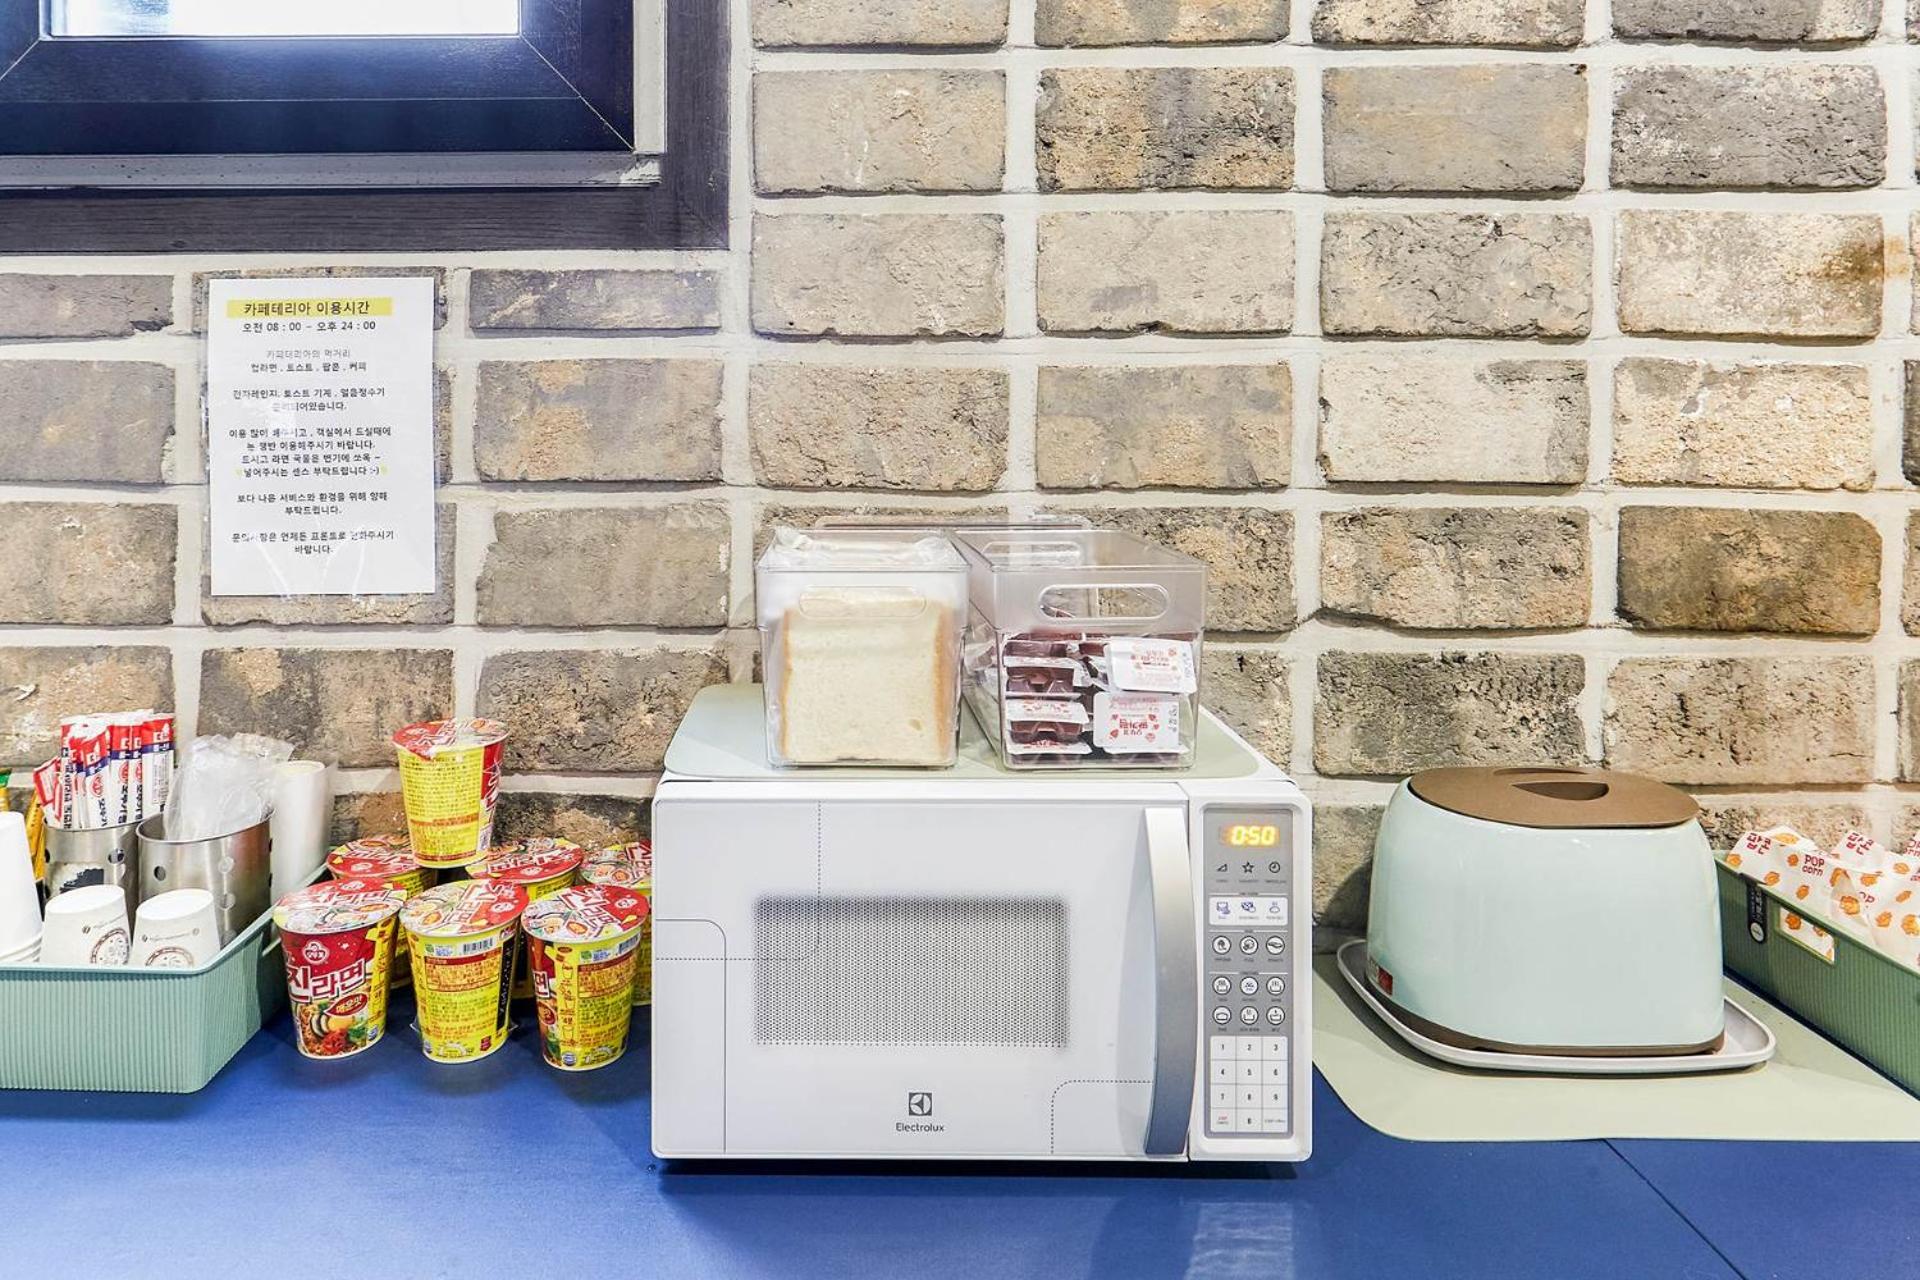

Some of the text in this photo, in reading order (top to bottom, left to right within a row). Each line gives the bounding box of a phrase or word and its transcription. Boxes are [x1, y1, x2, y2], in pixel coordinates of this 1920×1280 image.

[244, 301, 369, 315] 카페테리아 이용시간
[242, 322, 263, 333] 오전
[267, 322, 279, 331] 08
[289, 322, 301, 331] 00
[317, 321, 337, 331] 오후
[341, 321, 353, 330] 24
[363, 321, 376, 329] 00
[251, 363, 277, 373] 컵라면
[286, 363, 313, 372] 토스트
[284, 389, 310, 398] 토스트
[280, 441, 333, 450] 이용해주시기
[337, 440, 375, 450] 바랍니다.
[242, 455, 269, 464] 드시고
[271, 454, 289, 464] 라면
[237, 494, 254, 503] 보다
[259, 494, 275, 503] 나은
[280, 493, 315, 503] 서비스와
[285, 506, 342, 515] 부탁드립니다.
[295, 545, 333, 554] 바랍니다.
[1804, 854, 1824, 867] POP
[1802, 866, 1824, 876] corn
[286, 958, 365, 1002] 진라면
[896, 1122, 944, 1132] Electrolux
